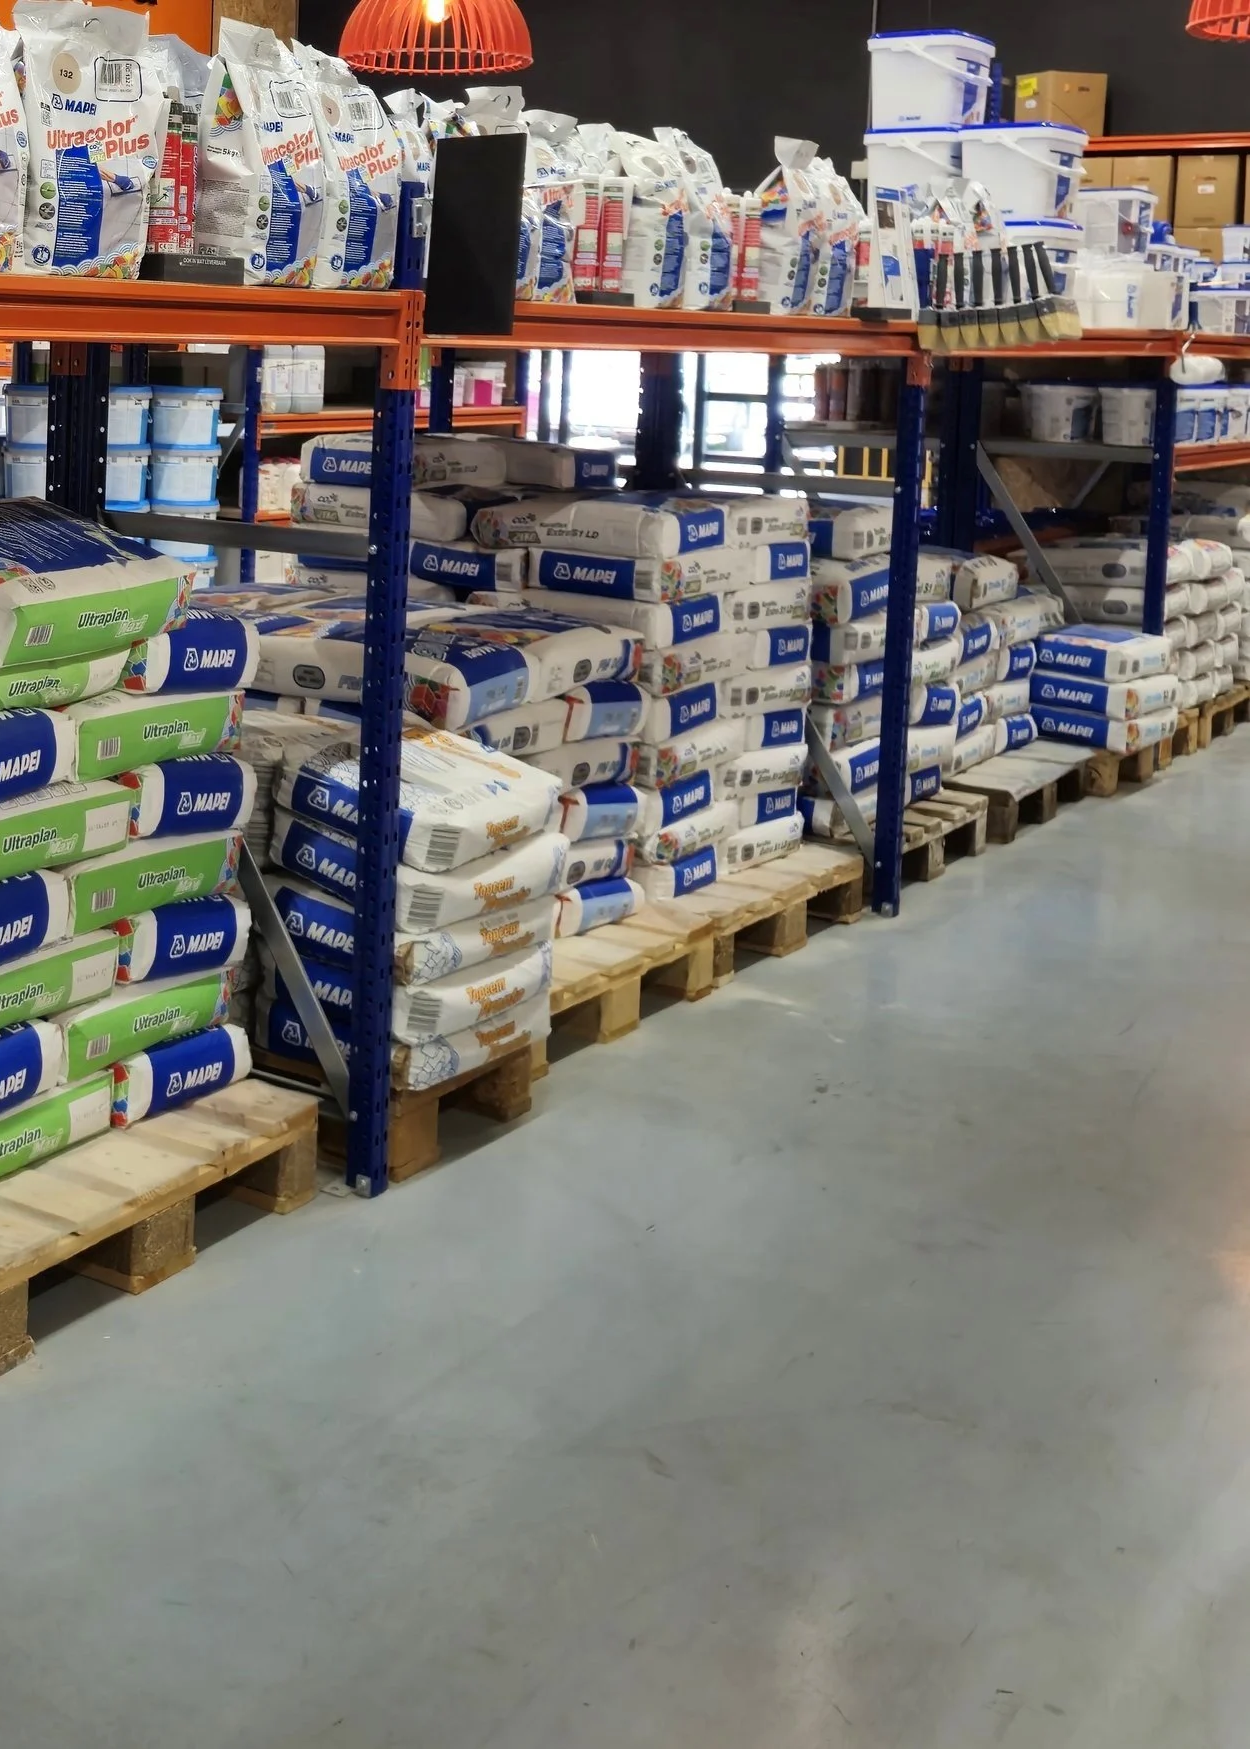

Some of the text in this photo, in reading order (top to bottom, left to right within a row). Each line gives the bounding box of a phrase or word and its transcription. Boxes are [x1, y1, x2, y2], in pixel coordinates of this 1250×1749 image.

[59, 68, 74, 80] 132
[65, 99, 97, 116] MAPEI
[47, 118, 150, 160] Ultracolor Plus
[261, 129, 314, 166] Ultracolor
[338, 142, 398, 180] Ultracolor Plus
[585, 530, 599, 539] LD
[440, 559, 480, 577] MAPEI
[573, 566, 617, 584] MAPEI
[77, 607, 130, 630] Ultraplan
[200, 649, 236, 669] MAPEI
[1055, 653, 1092, 668] MAPEI
[8, 676, 61, 698] Ultraplan
[1057, 688, 1093, 704] MAPEI
[142, 719, 189, 742] Ultraplan
[1057, 722, 1094, 738] MAPEI
[193, 792, 231, 812] MAPEI
[2, 827, 57, 855] Ultraplan
[137, 867, 186, 890] Ultraplan
[474, 876, 515, 900] Topcem
[186, 931, 225, 955] MAPEI
[481, 921, 520, 946] Topcem
[133, 1006, 182, 1034] Ultraplan
[183, 1061, 223, 1090] MAPEI
